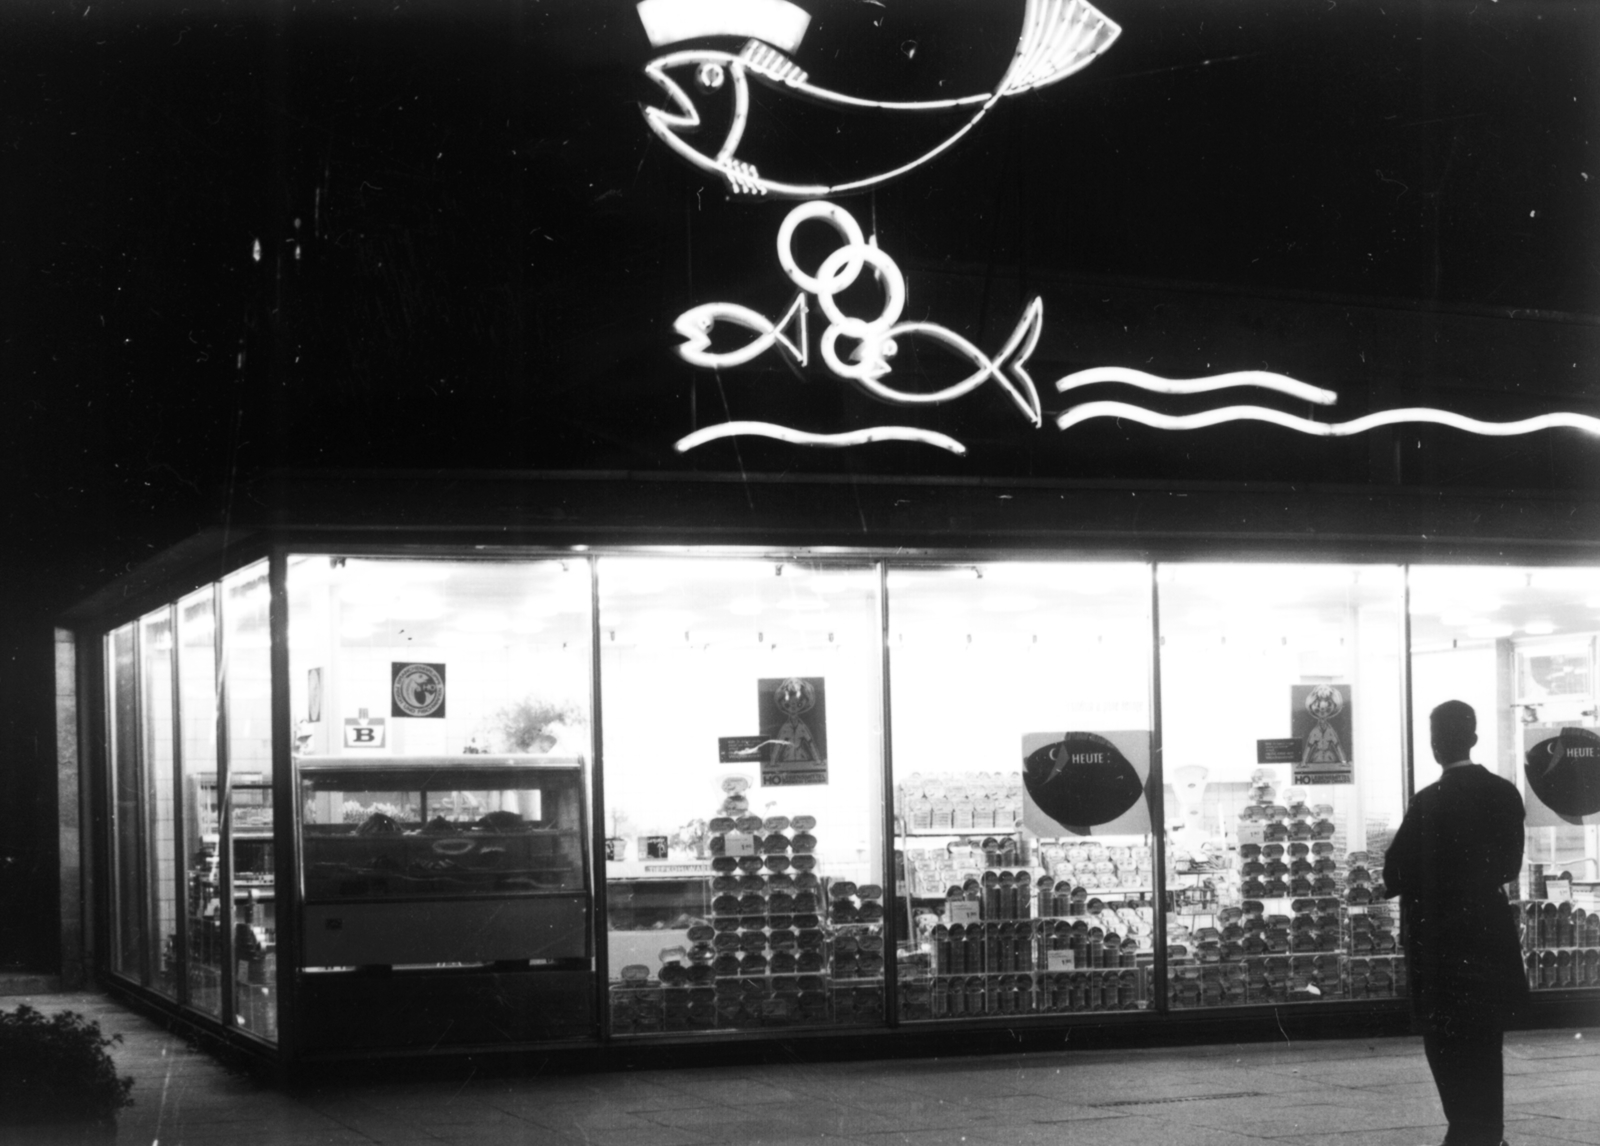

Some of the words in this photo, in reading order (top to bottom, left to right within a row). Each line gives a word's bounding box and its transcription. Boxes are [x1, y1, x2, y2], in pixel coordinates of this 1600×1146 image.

[353, 728, 375, 742] B
[763, 775, 781, 785] HO
[1295, 775, 1311, 785] HO
